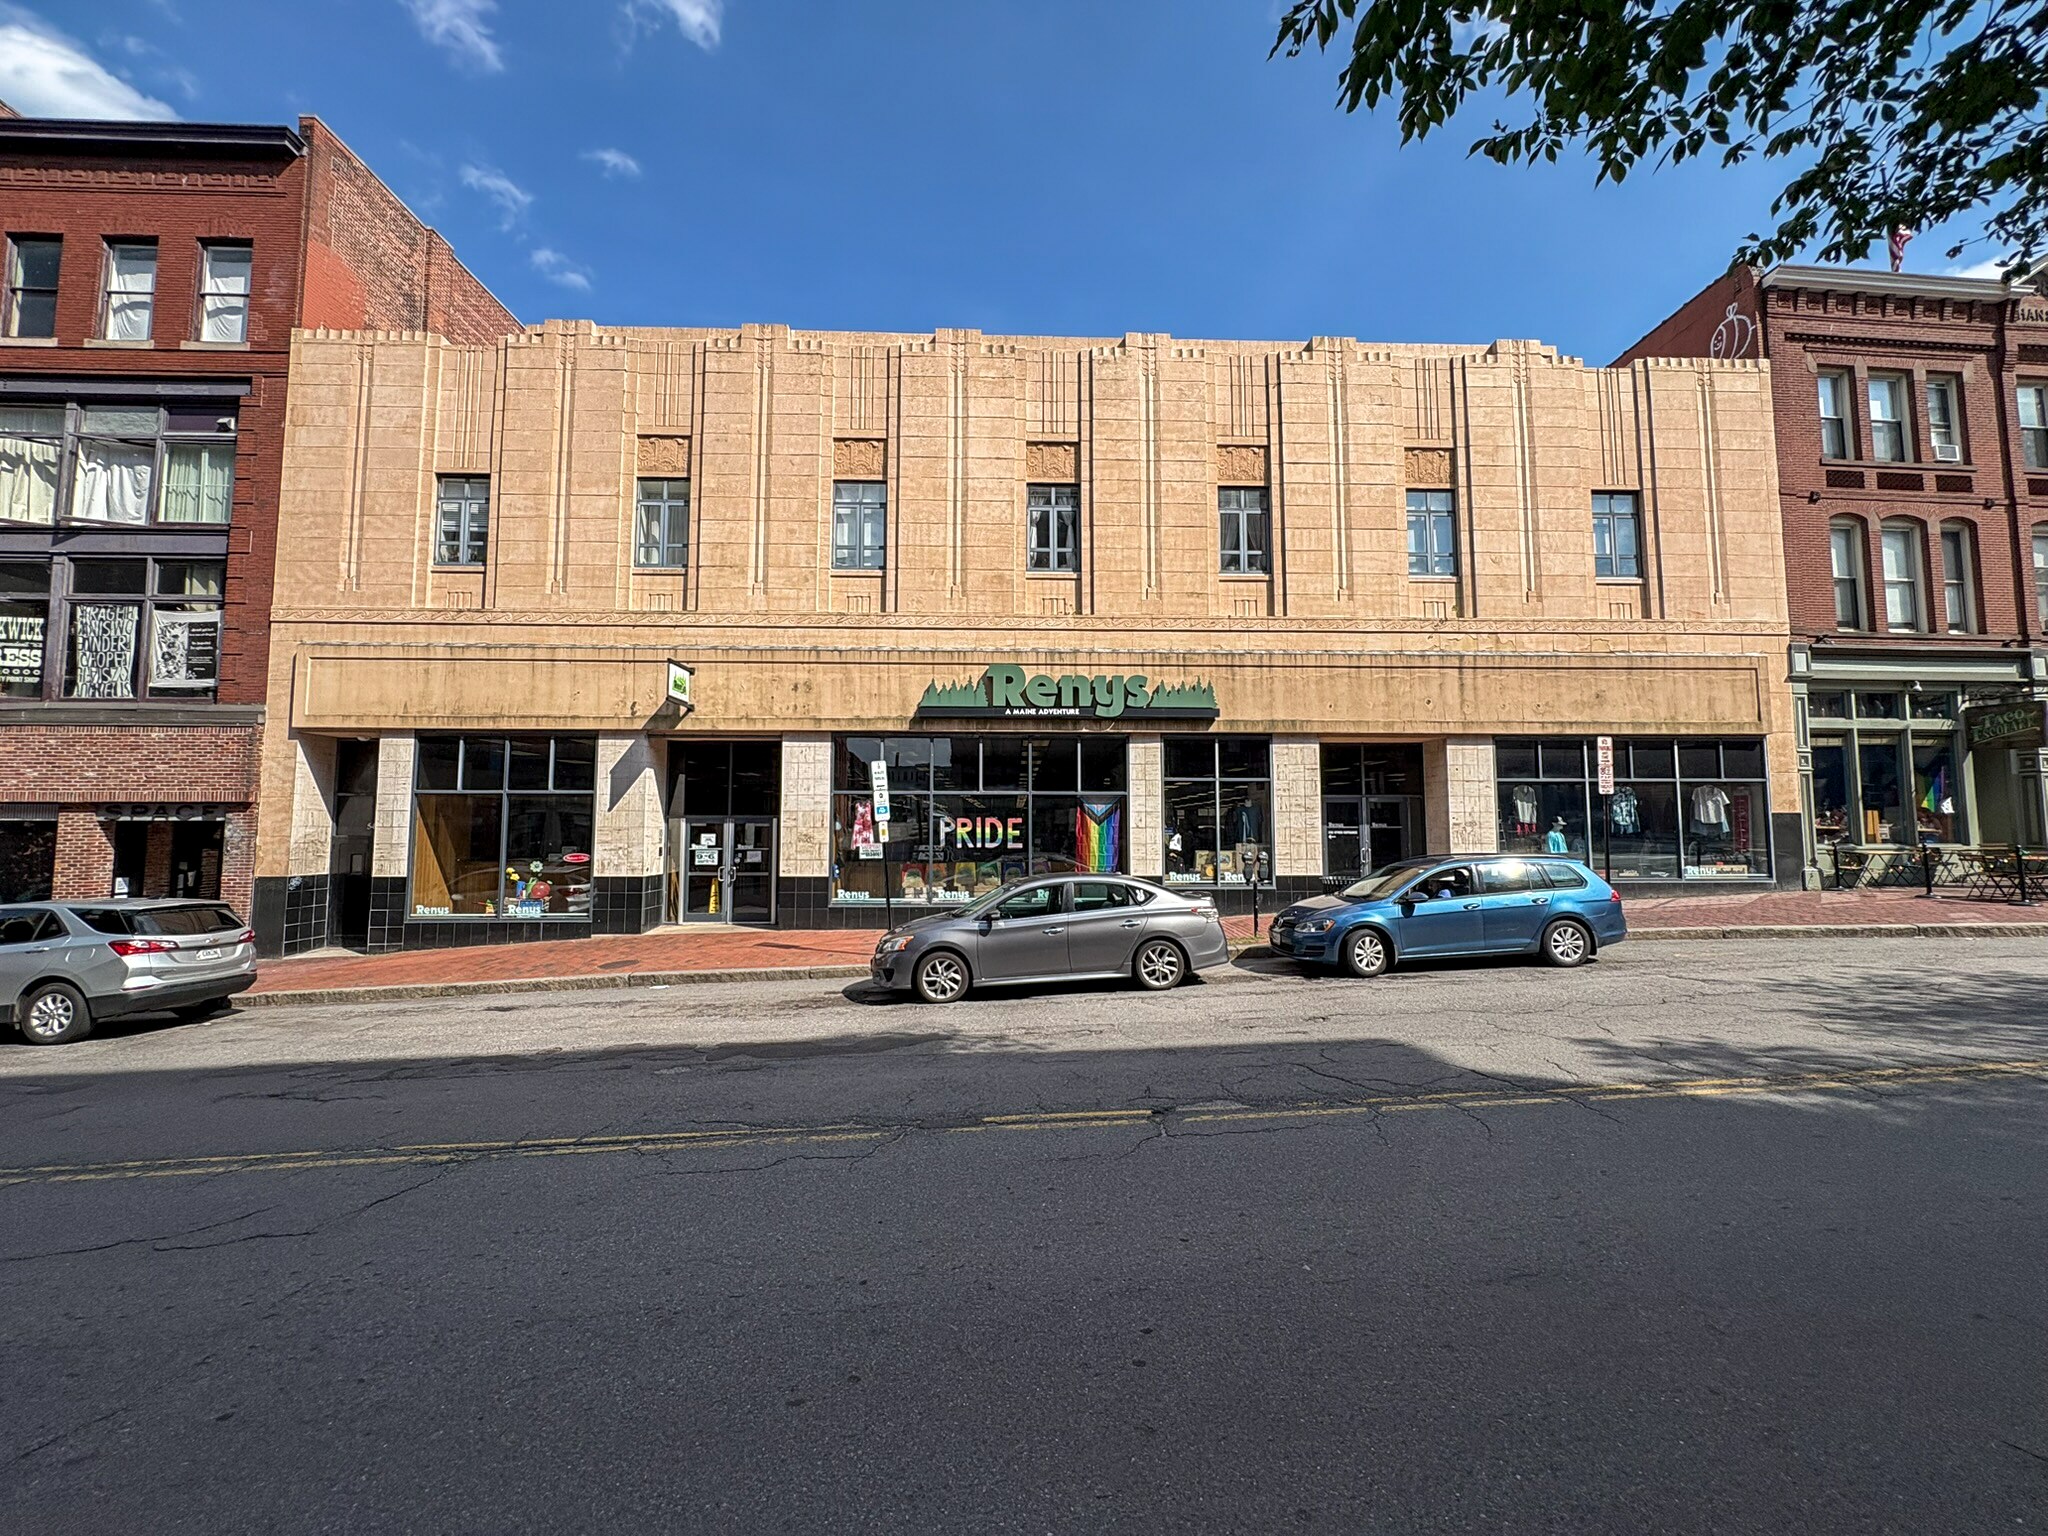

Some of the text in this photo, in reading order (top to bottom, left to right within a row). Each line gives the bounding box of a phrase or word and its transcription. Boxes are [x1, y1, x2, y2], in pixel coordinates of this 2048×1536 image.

[987, 664, 1151, 718] Renys
[940, 817, 1024, 849] PRIDE
[1169, 871, 1201, 882] Renys
[1224, 871, 1255, 882] Ren
[1687, 866, 1717, 876] Renys
[837, 889, 870, 900] Renys
[938, 889, 970, 900] Renys
[416, 904, 450, 915] Renys
[508, 904, 541, 914] Renys
